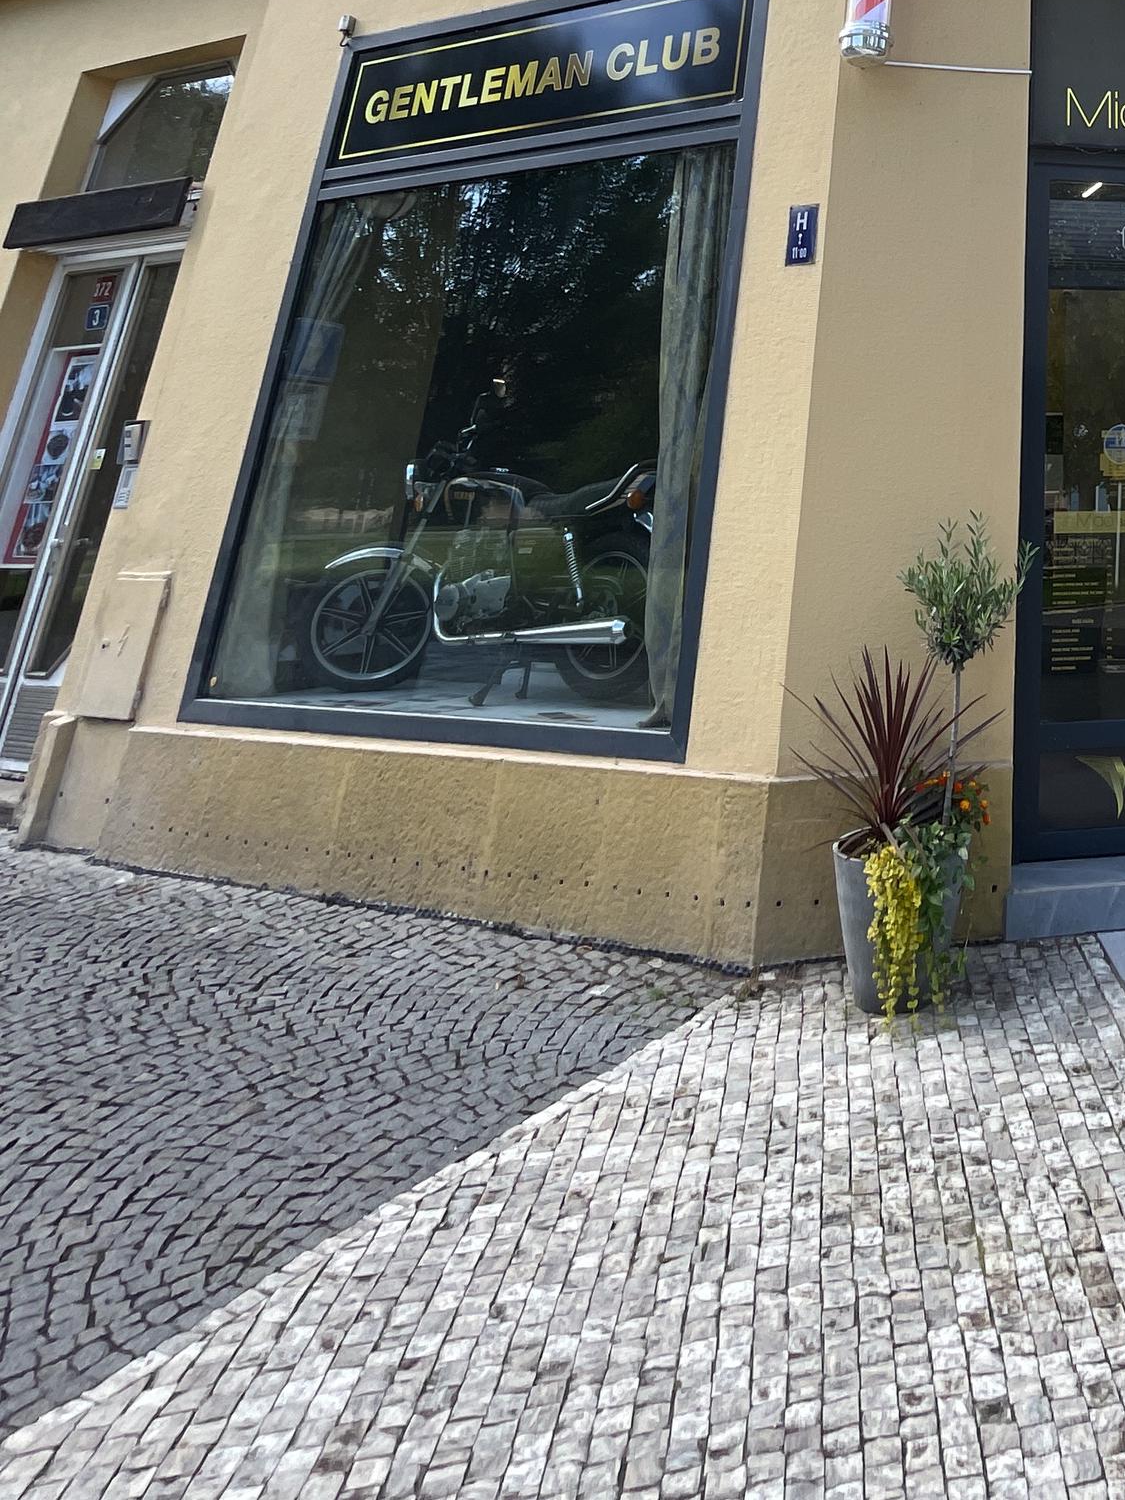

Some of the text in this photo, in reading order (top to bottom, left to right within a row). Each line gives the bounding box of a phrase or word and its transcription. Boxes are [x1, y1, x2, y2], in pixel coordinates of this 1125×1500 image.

[364, 26, 721, 124] GENTLEMAN CLUB
[796, 212, 808, 231] H
[92, 310, 100, 326] 3
